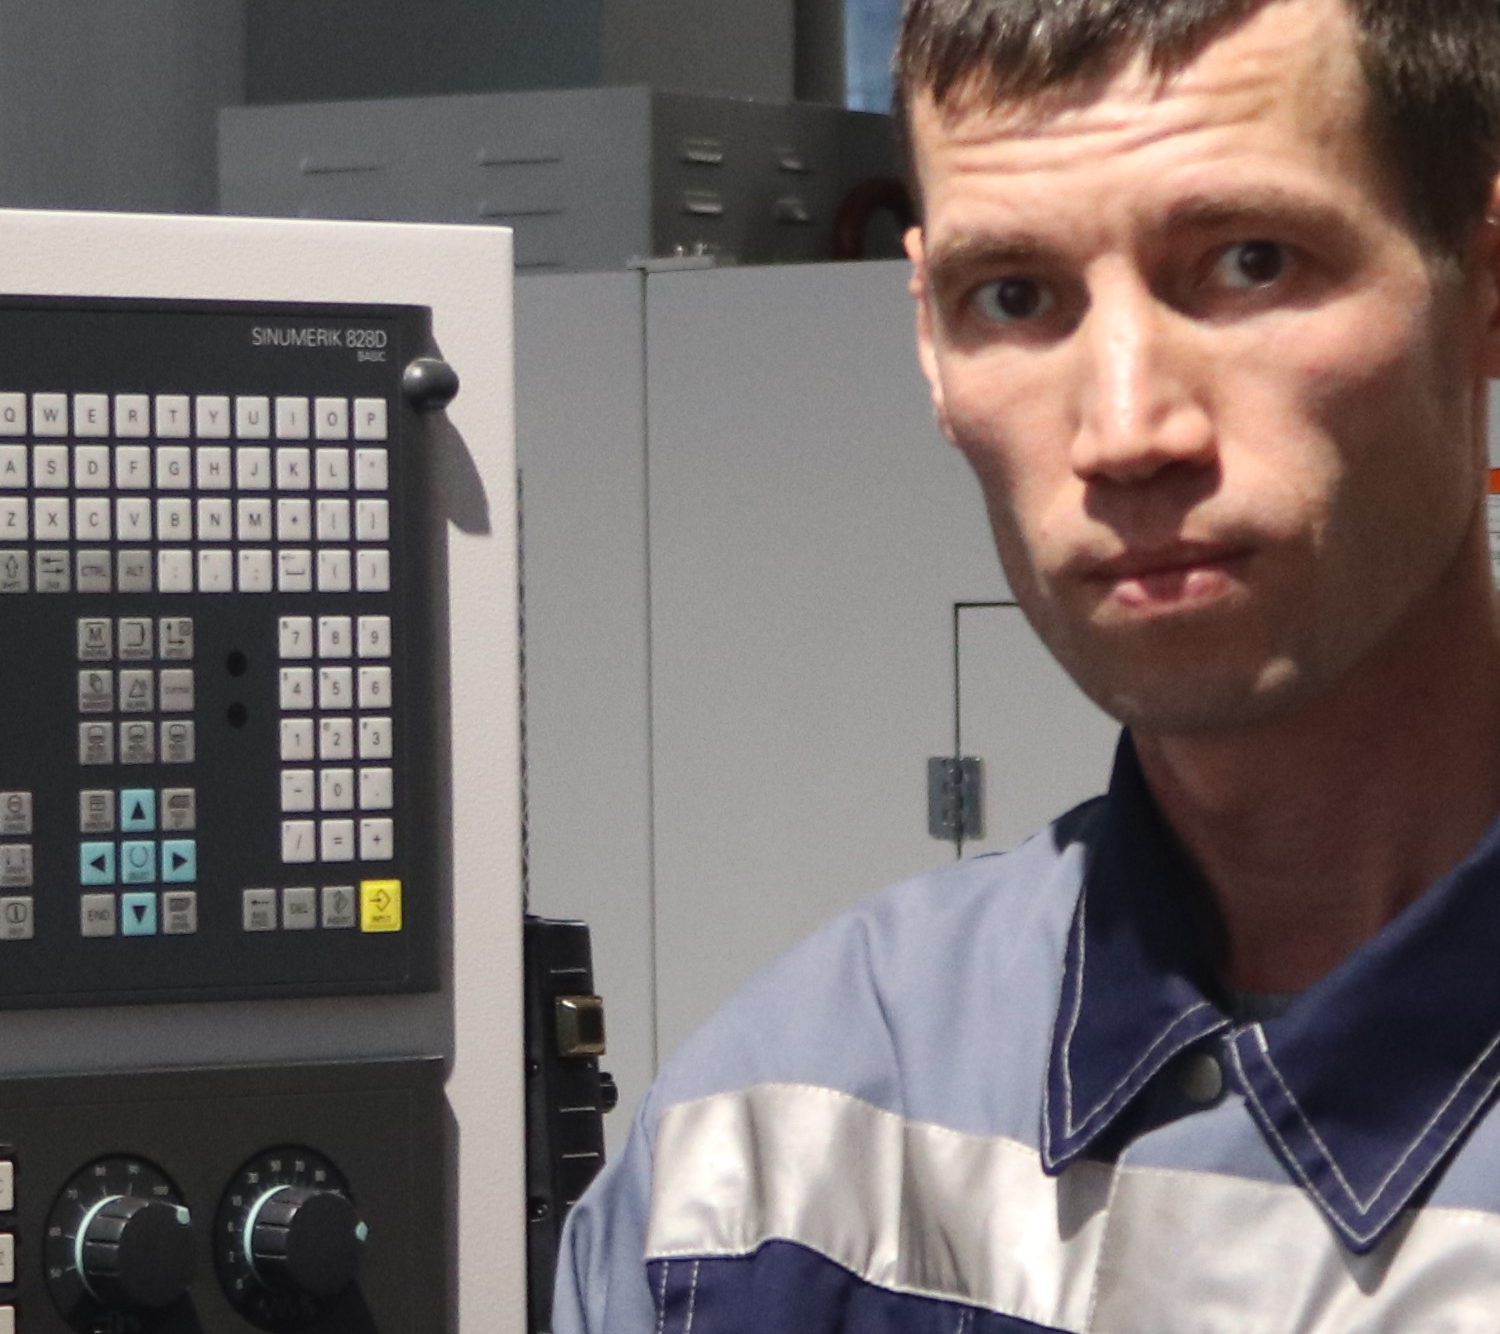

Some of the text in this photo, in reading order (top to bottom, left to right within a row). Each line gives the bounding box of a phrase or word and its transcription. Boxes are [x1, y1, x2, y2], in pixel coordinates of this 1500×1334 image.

[252, 327, 388, 349] SINUMERIK 828D
[3, 406, 16, 423] Q
[43, 408, 57, 422] W
[87, 408, 96, 424] E
[128, 409, 138, 422] R
[169, 408, 178, 423] T
[208, 410, 219, 424] Y
[247, 411, 260, 426] U
[326, 411, 339, 427] O
[366, 411, 376, 426] P
[5, 459, 338, 478] A S D F G H J K L
[6, 511, 16, 528] Z
[48, 512, 58, 526] X
[88, 511, 99, 528] C
[129, 513, 140, 527] V
[170, 512, 180, 528] B
[209, 513, 221, 527] N
[248, 513, 262, 527] M
[292, 630, 380, 645] 7 8 9
[292, 680, 380, 696] 4 5 6
[294, 731, 381, 747] 1 2 3
[333, 782, 342, 798] 0
